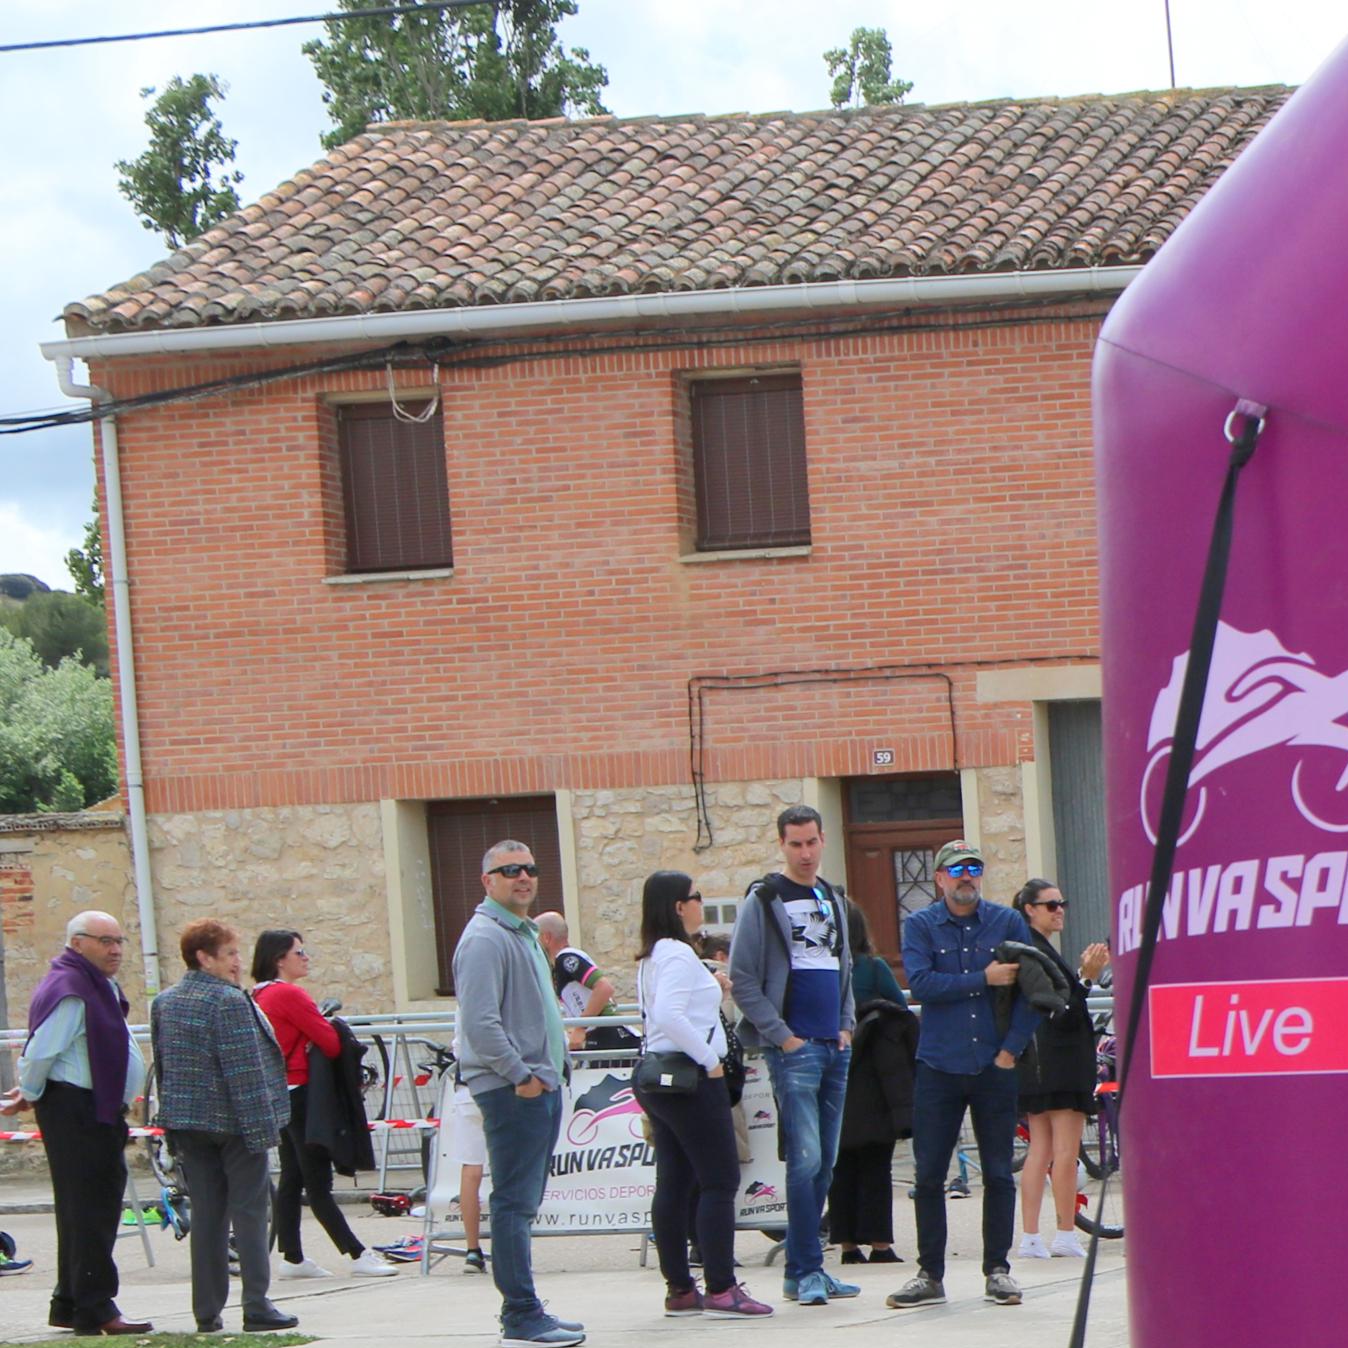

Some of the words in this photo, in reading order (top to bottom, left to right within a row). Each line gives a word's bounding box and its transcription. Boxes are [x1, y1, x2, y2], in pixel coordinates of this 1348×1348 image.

[876, 752, 891, 763] 59
[1188, 994, 1314, 1058] Live
[543, 1187, 606, 1201] ERVICIOS
